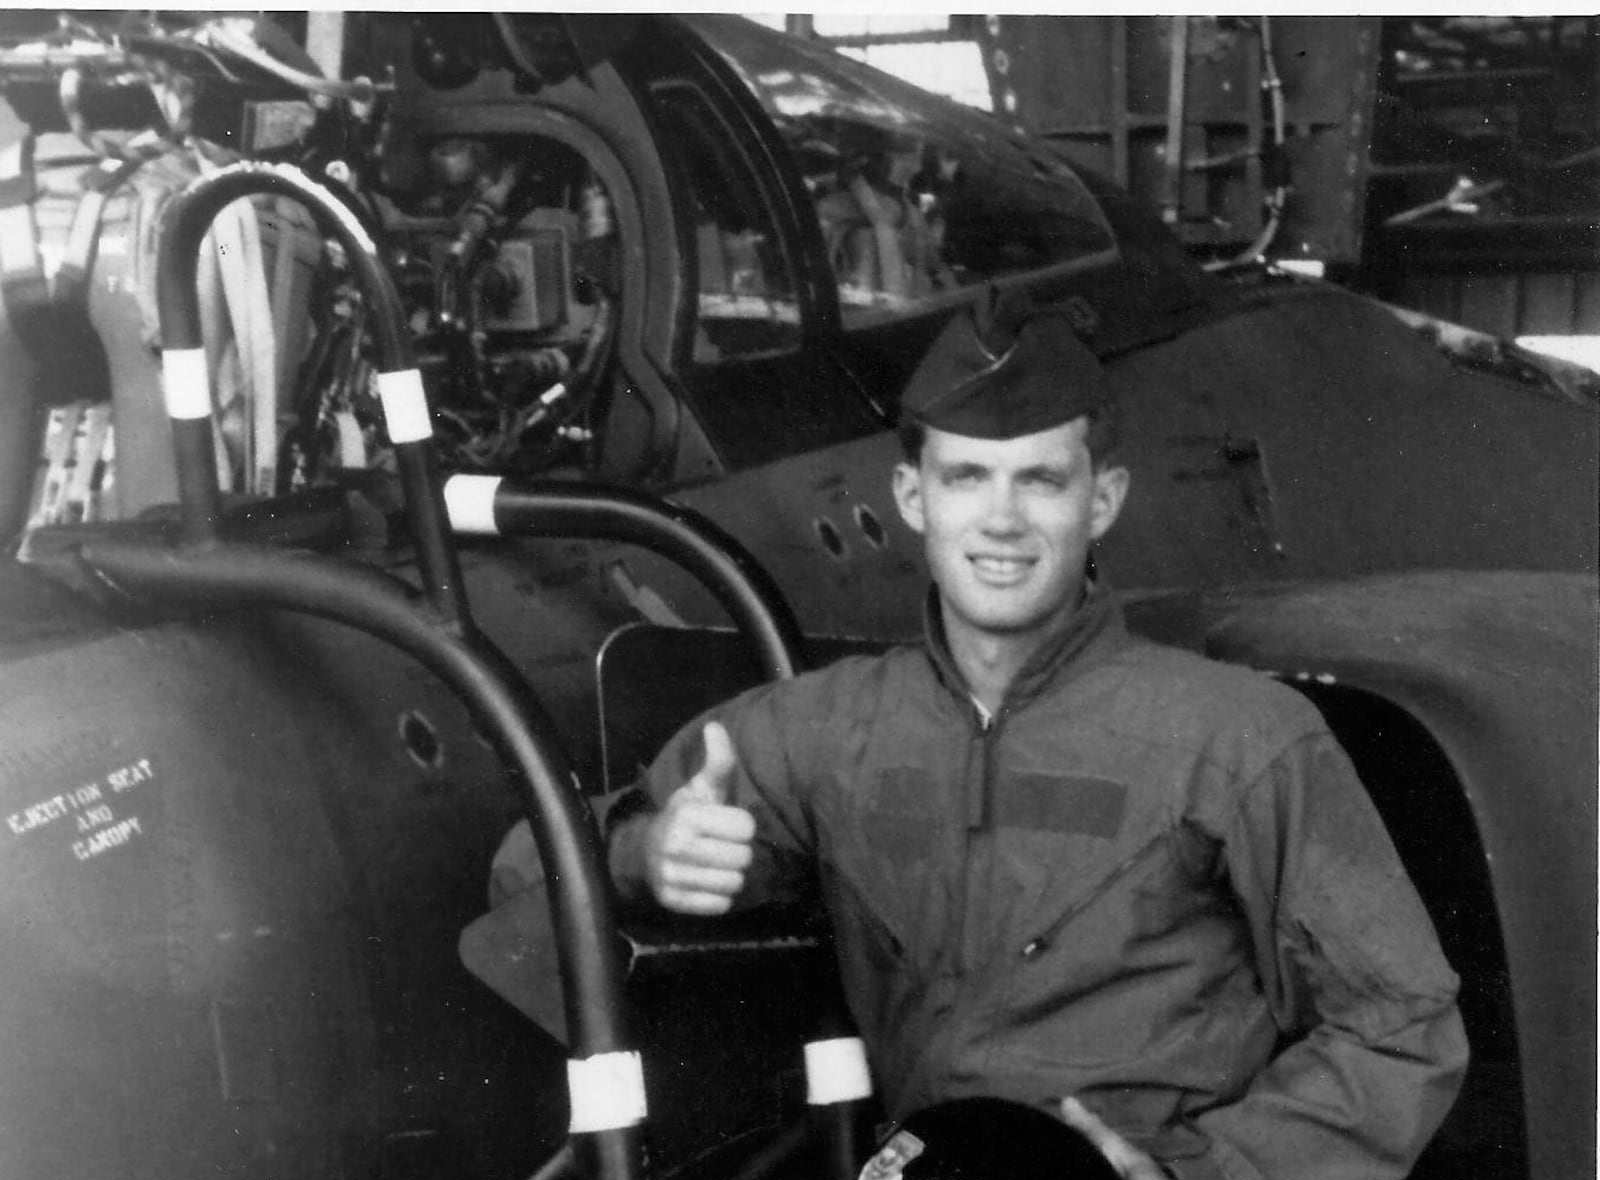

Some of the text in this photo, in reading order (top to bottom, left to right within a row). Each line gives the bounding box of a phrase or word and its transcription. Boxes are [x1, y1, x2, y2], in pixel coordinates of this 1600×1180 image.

[6, 759, 153, 834] EJECTION SEAT
[76, 804, 113, 833] AND
[72, 816, 142, 861] CANOPY
